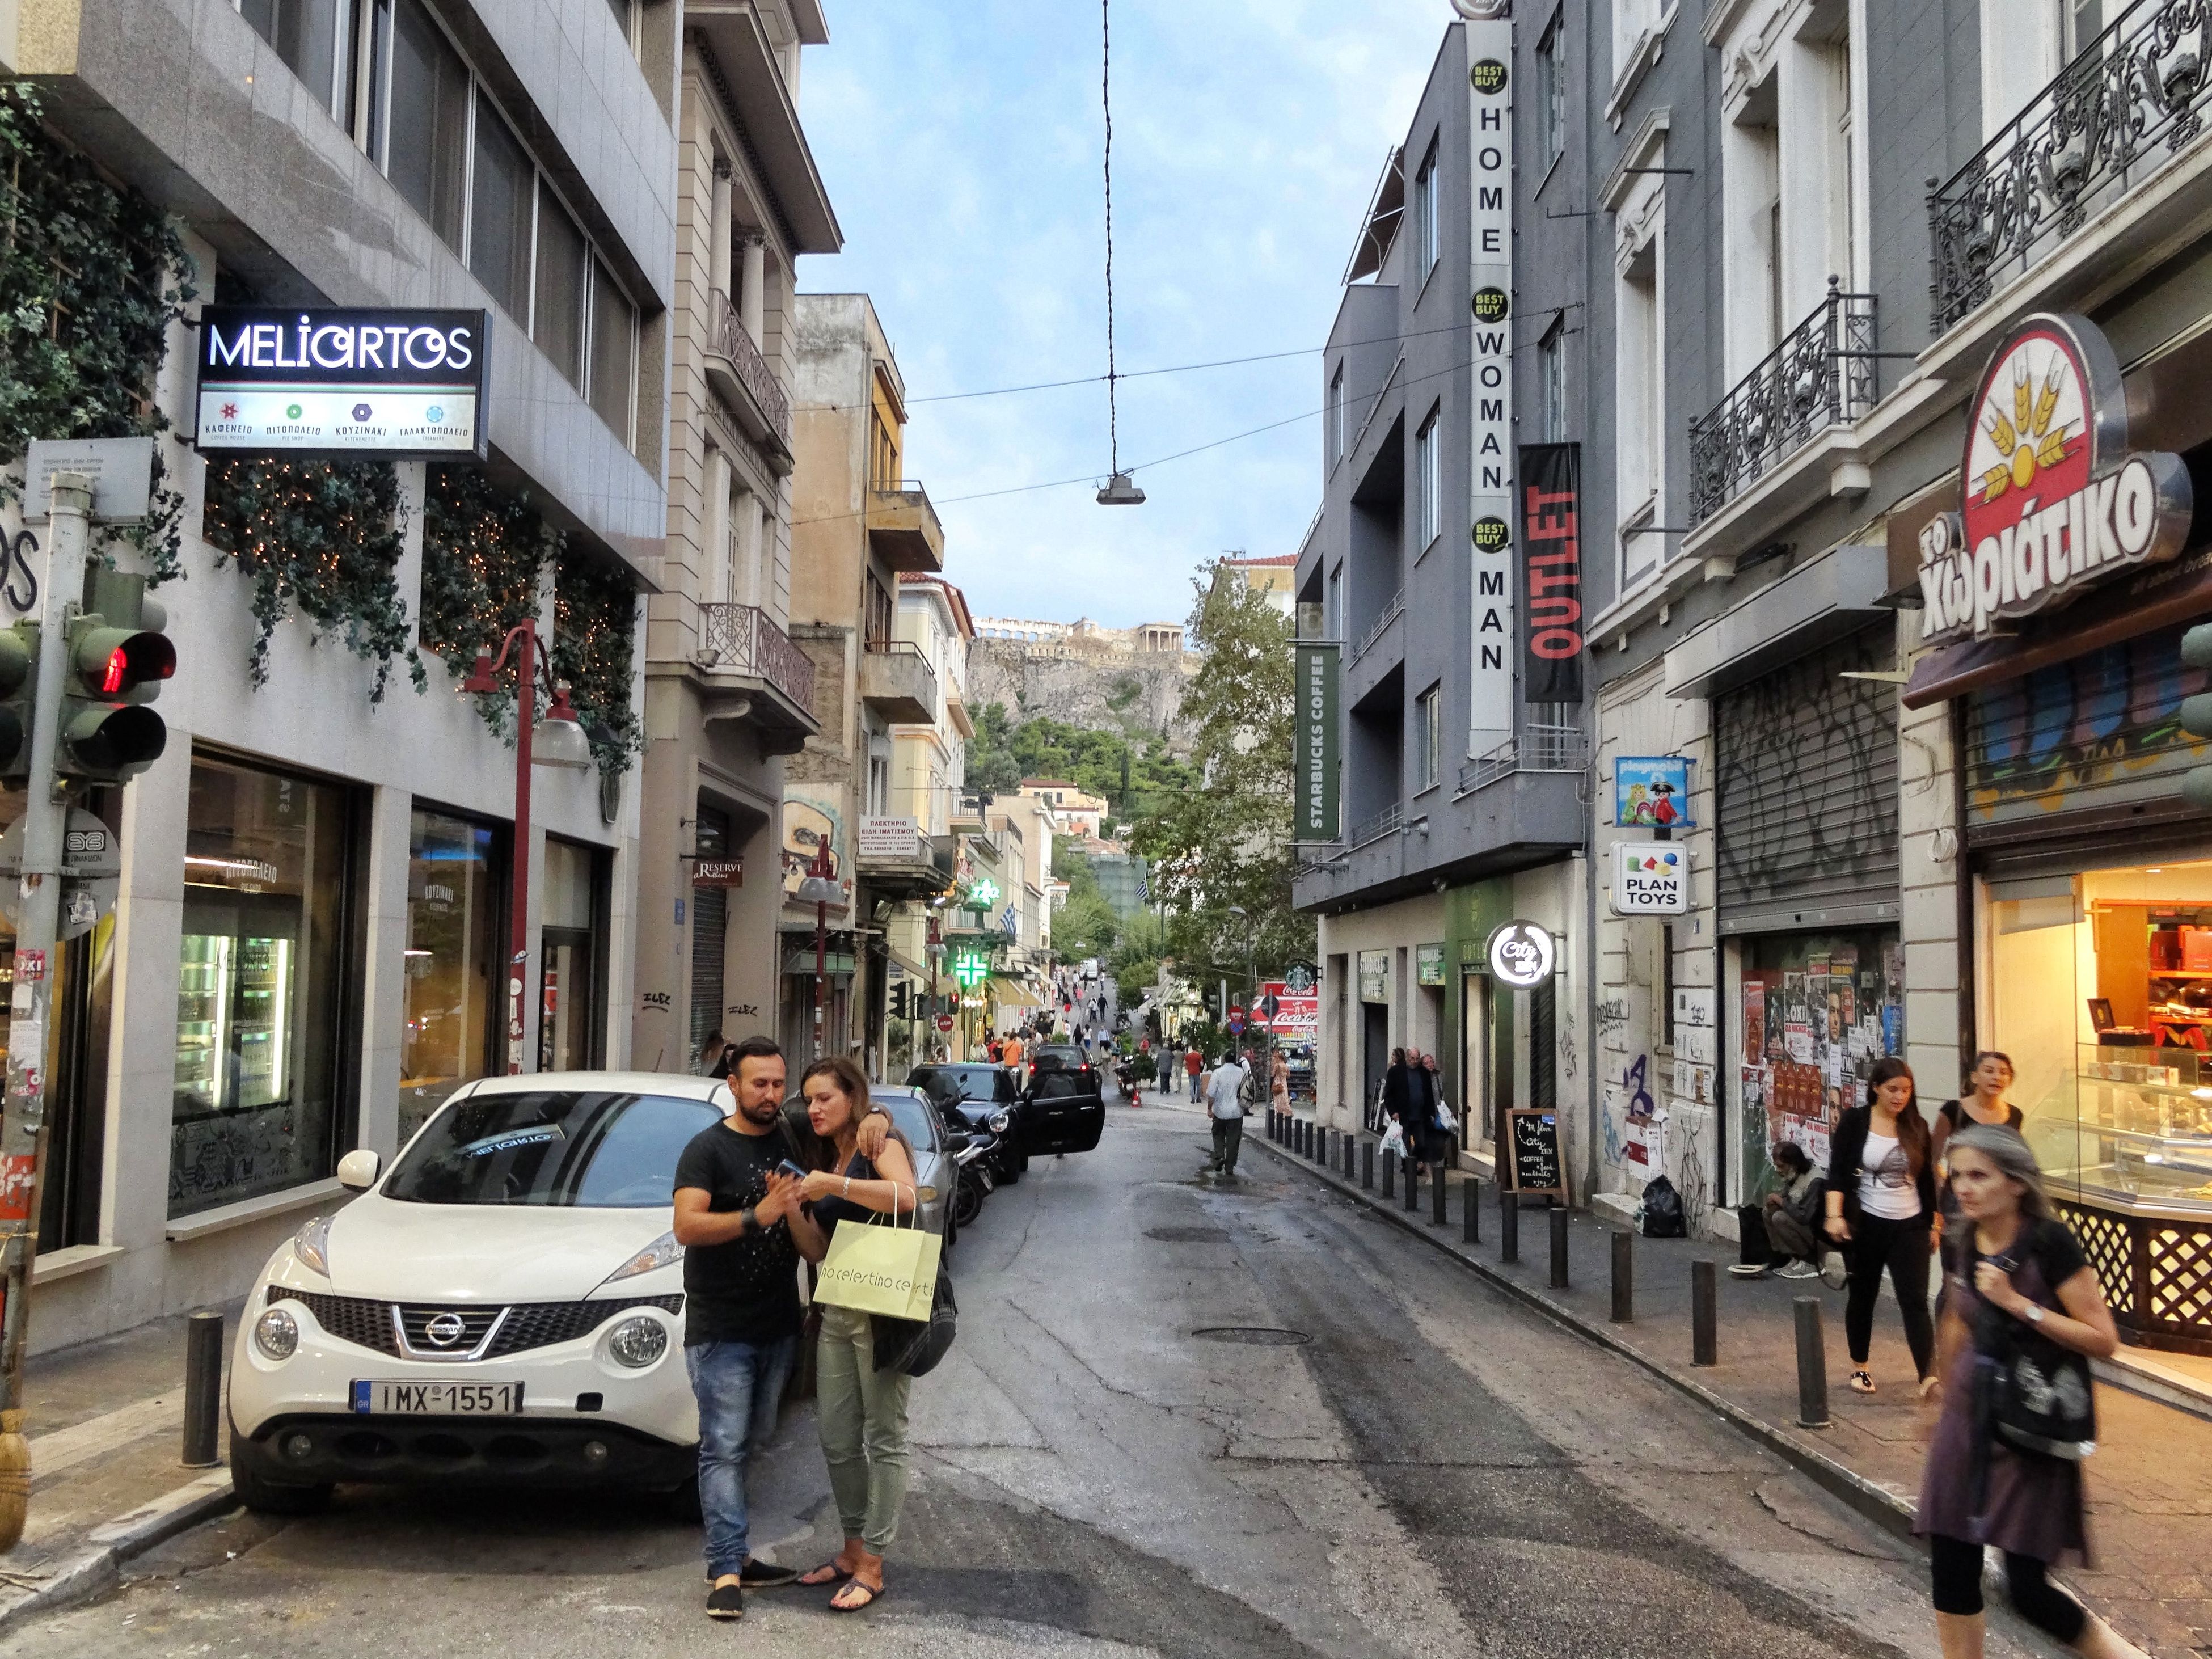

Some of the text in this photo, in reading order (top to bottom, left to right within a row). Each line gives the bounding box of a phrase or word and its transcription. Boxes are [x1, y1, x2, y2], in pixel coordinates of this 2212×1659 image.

[1475, 66, 1503, 76] BEST
[1475, 77, 1498, 86] BUY
[1479, 107, 1502, 252] HOME
[1476, 294, 1504, 305] BEST
[1476, 305, 1500, 314] BUY
[1476, 332, 1504, 488] WOMAN
[205, 424, 468, 437] ΚΑΦΕΝΕΙΟ ΠΙΤΟΠΩΛΕΙΟ ΚΟΥΖΙΝΑΚΙ ΓΑΛΑΚΤΟΠΩΛΕΙΟ
[1476, 524, 1505, 534] BEST
[1476, 534, 1501, 544] BUY
[0, 524, 39, 612] S
[1527, 486, 1582, 660] OUTLET
[1479, 571, 1504, 670] MAN
[1311, 655, 1324, 829] STARBUCKS COFFEE
[699, 863, 742, 878] RESERVE
[1626, 879, 1677, 891] PLAN
[1627, 892, 1677, 905] TOYS
[837, 1269, 893, 1289] celestino
